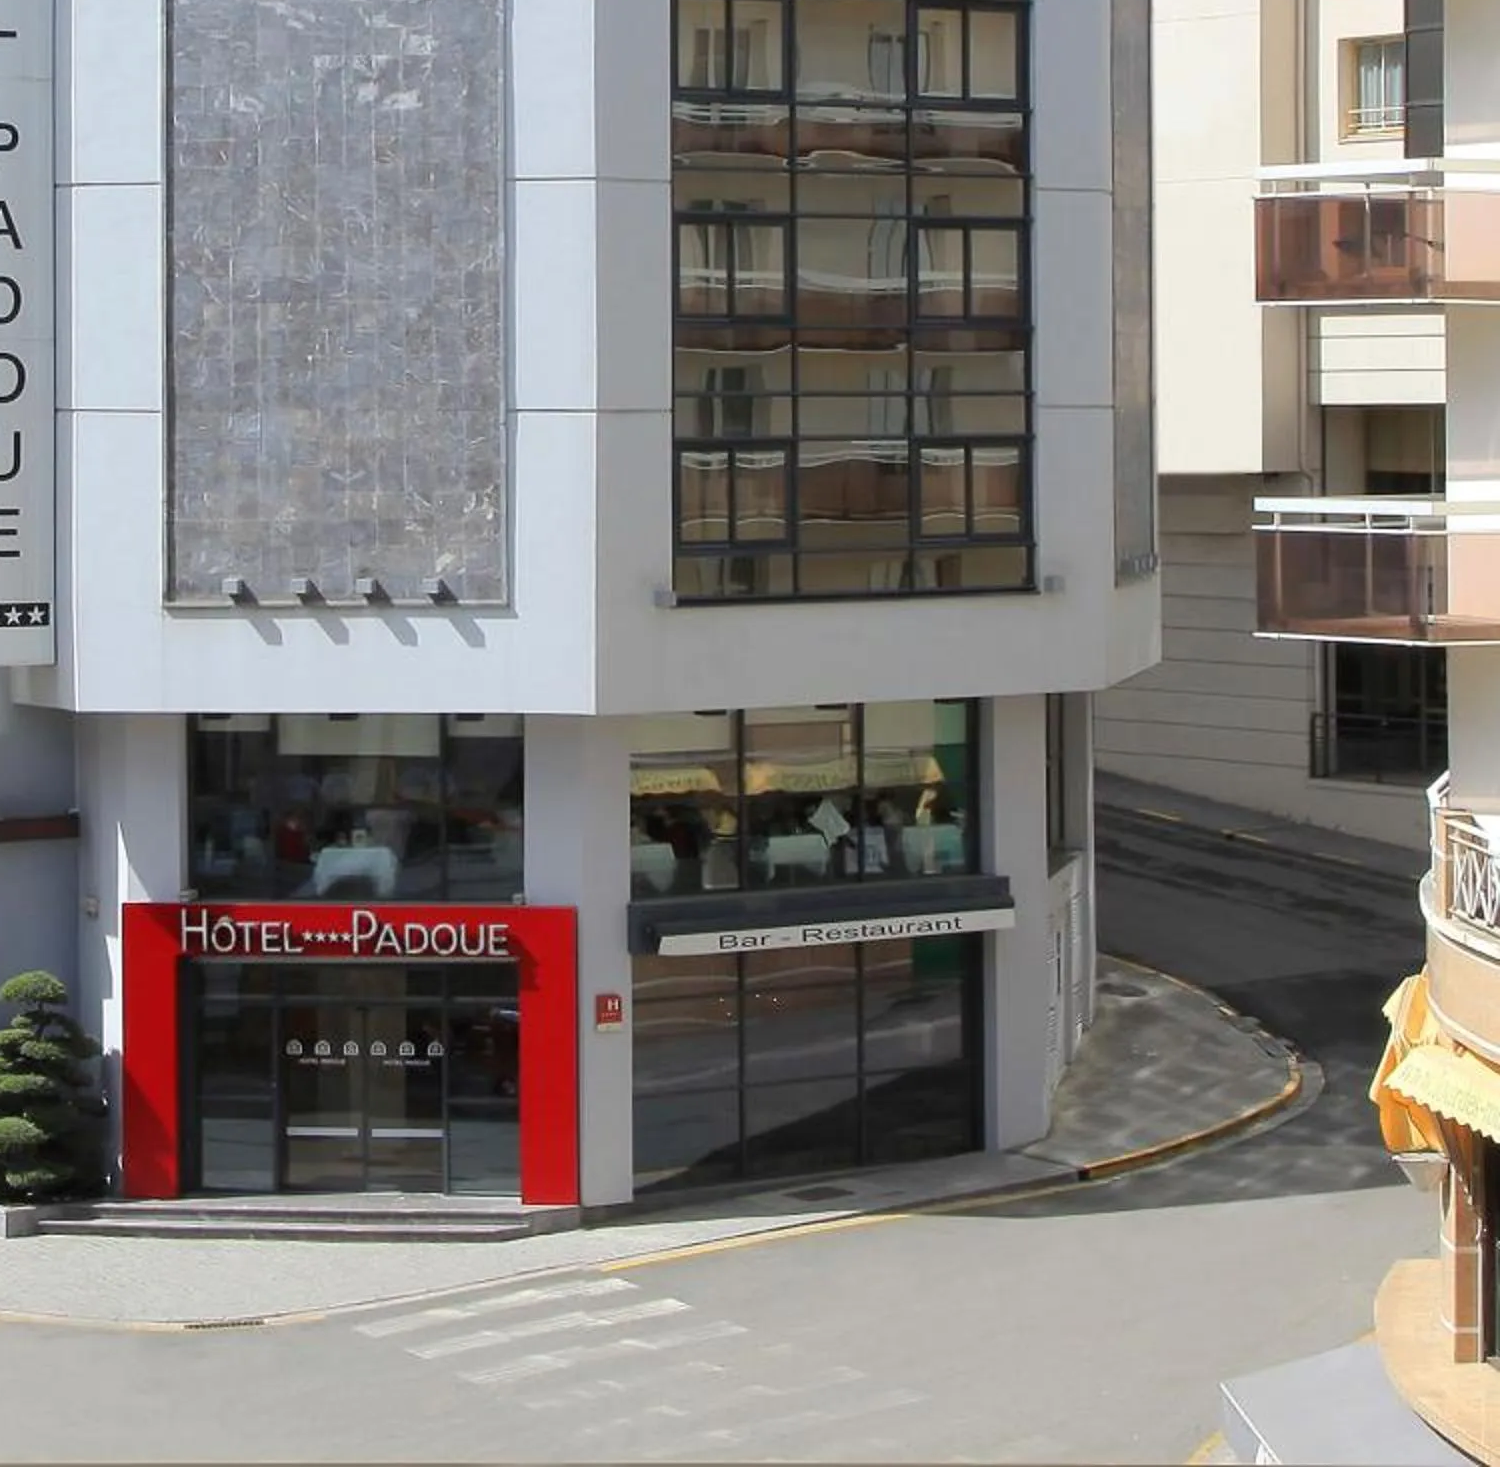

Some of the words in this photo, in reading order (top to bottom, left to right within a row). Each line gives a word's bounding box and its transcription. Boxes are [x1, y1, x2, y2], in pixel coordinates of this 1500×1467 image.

[181, 907, 304, 953] HÔTEL
[352, 910, 509, 955] PADOUE
[719, 934, 770, 950] Bar
[802, 916, 962, 942] Restaurant
[607, 998, 619, 1011] H
